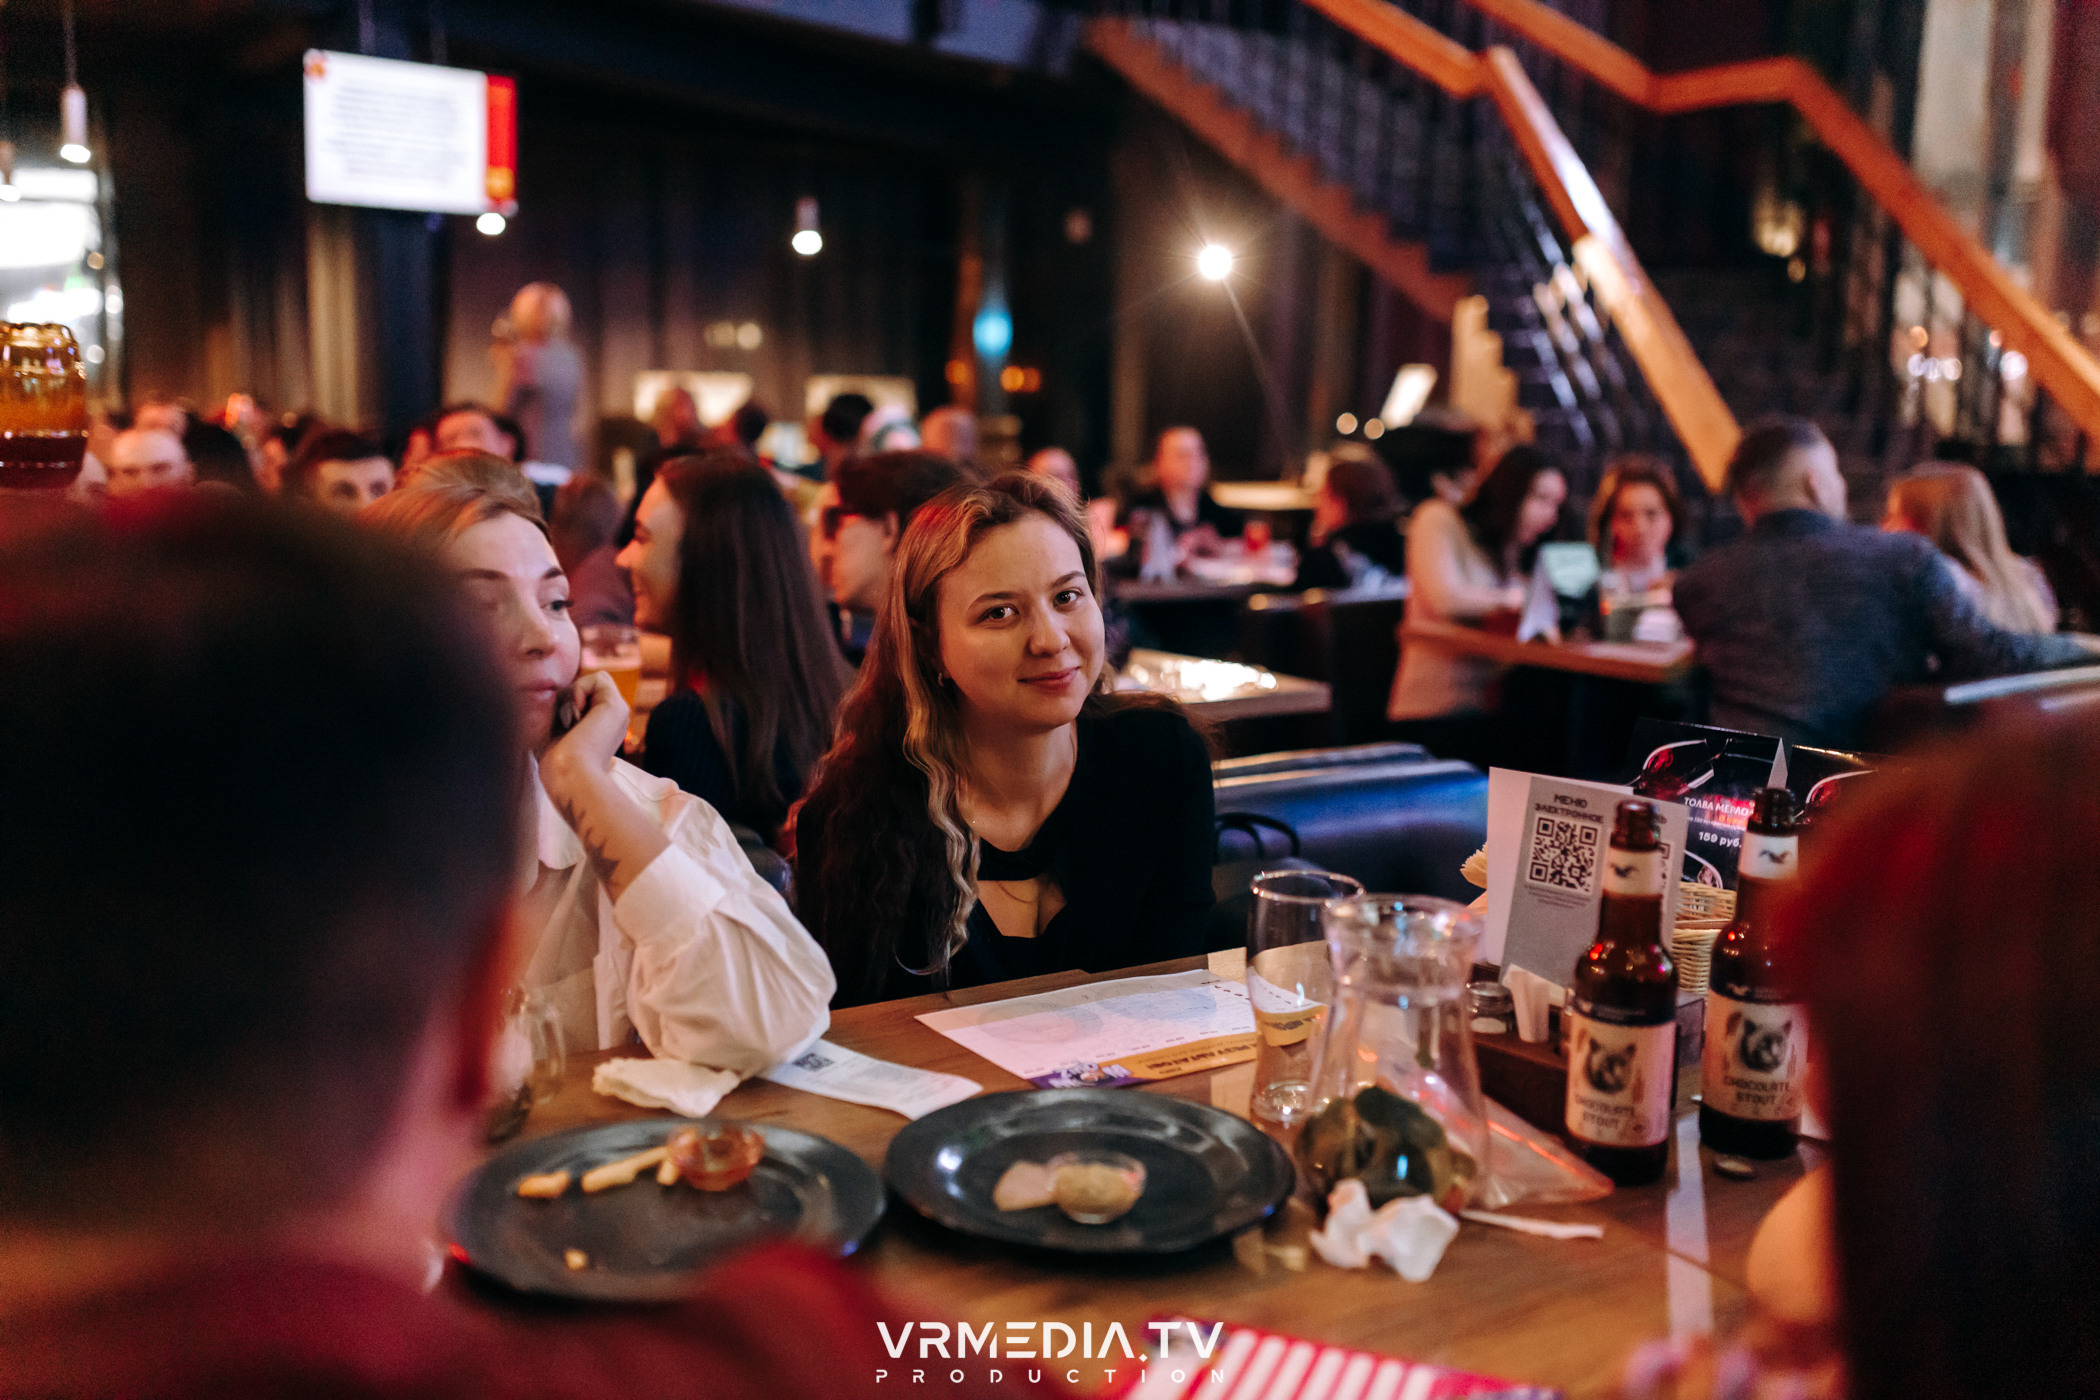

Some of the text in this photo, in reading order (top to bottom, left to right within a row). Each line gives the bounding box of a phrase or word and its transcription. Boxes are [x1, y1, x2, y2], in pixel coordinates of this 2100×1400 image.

[1554, 794, 1588, 808] МЕНЮ
[1535, 803, 1604, 824] ЭЛЕКТРОННОЕ
[1699, 831, 1742, 848] 159 руб.
